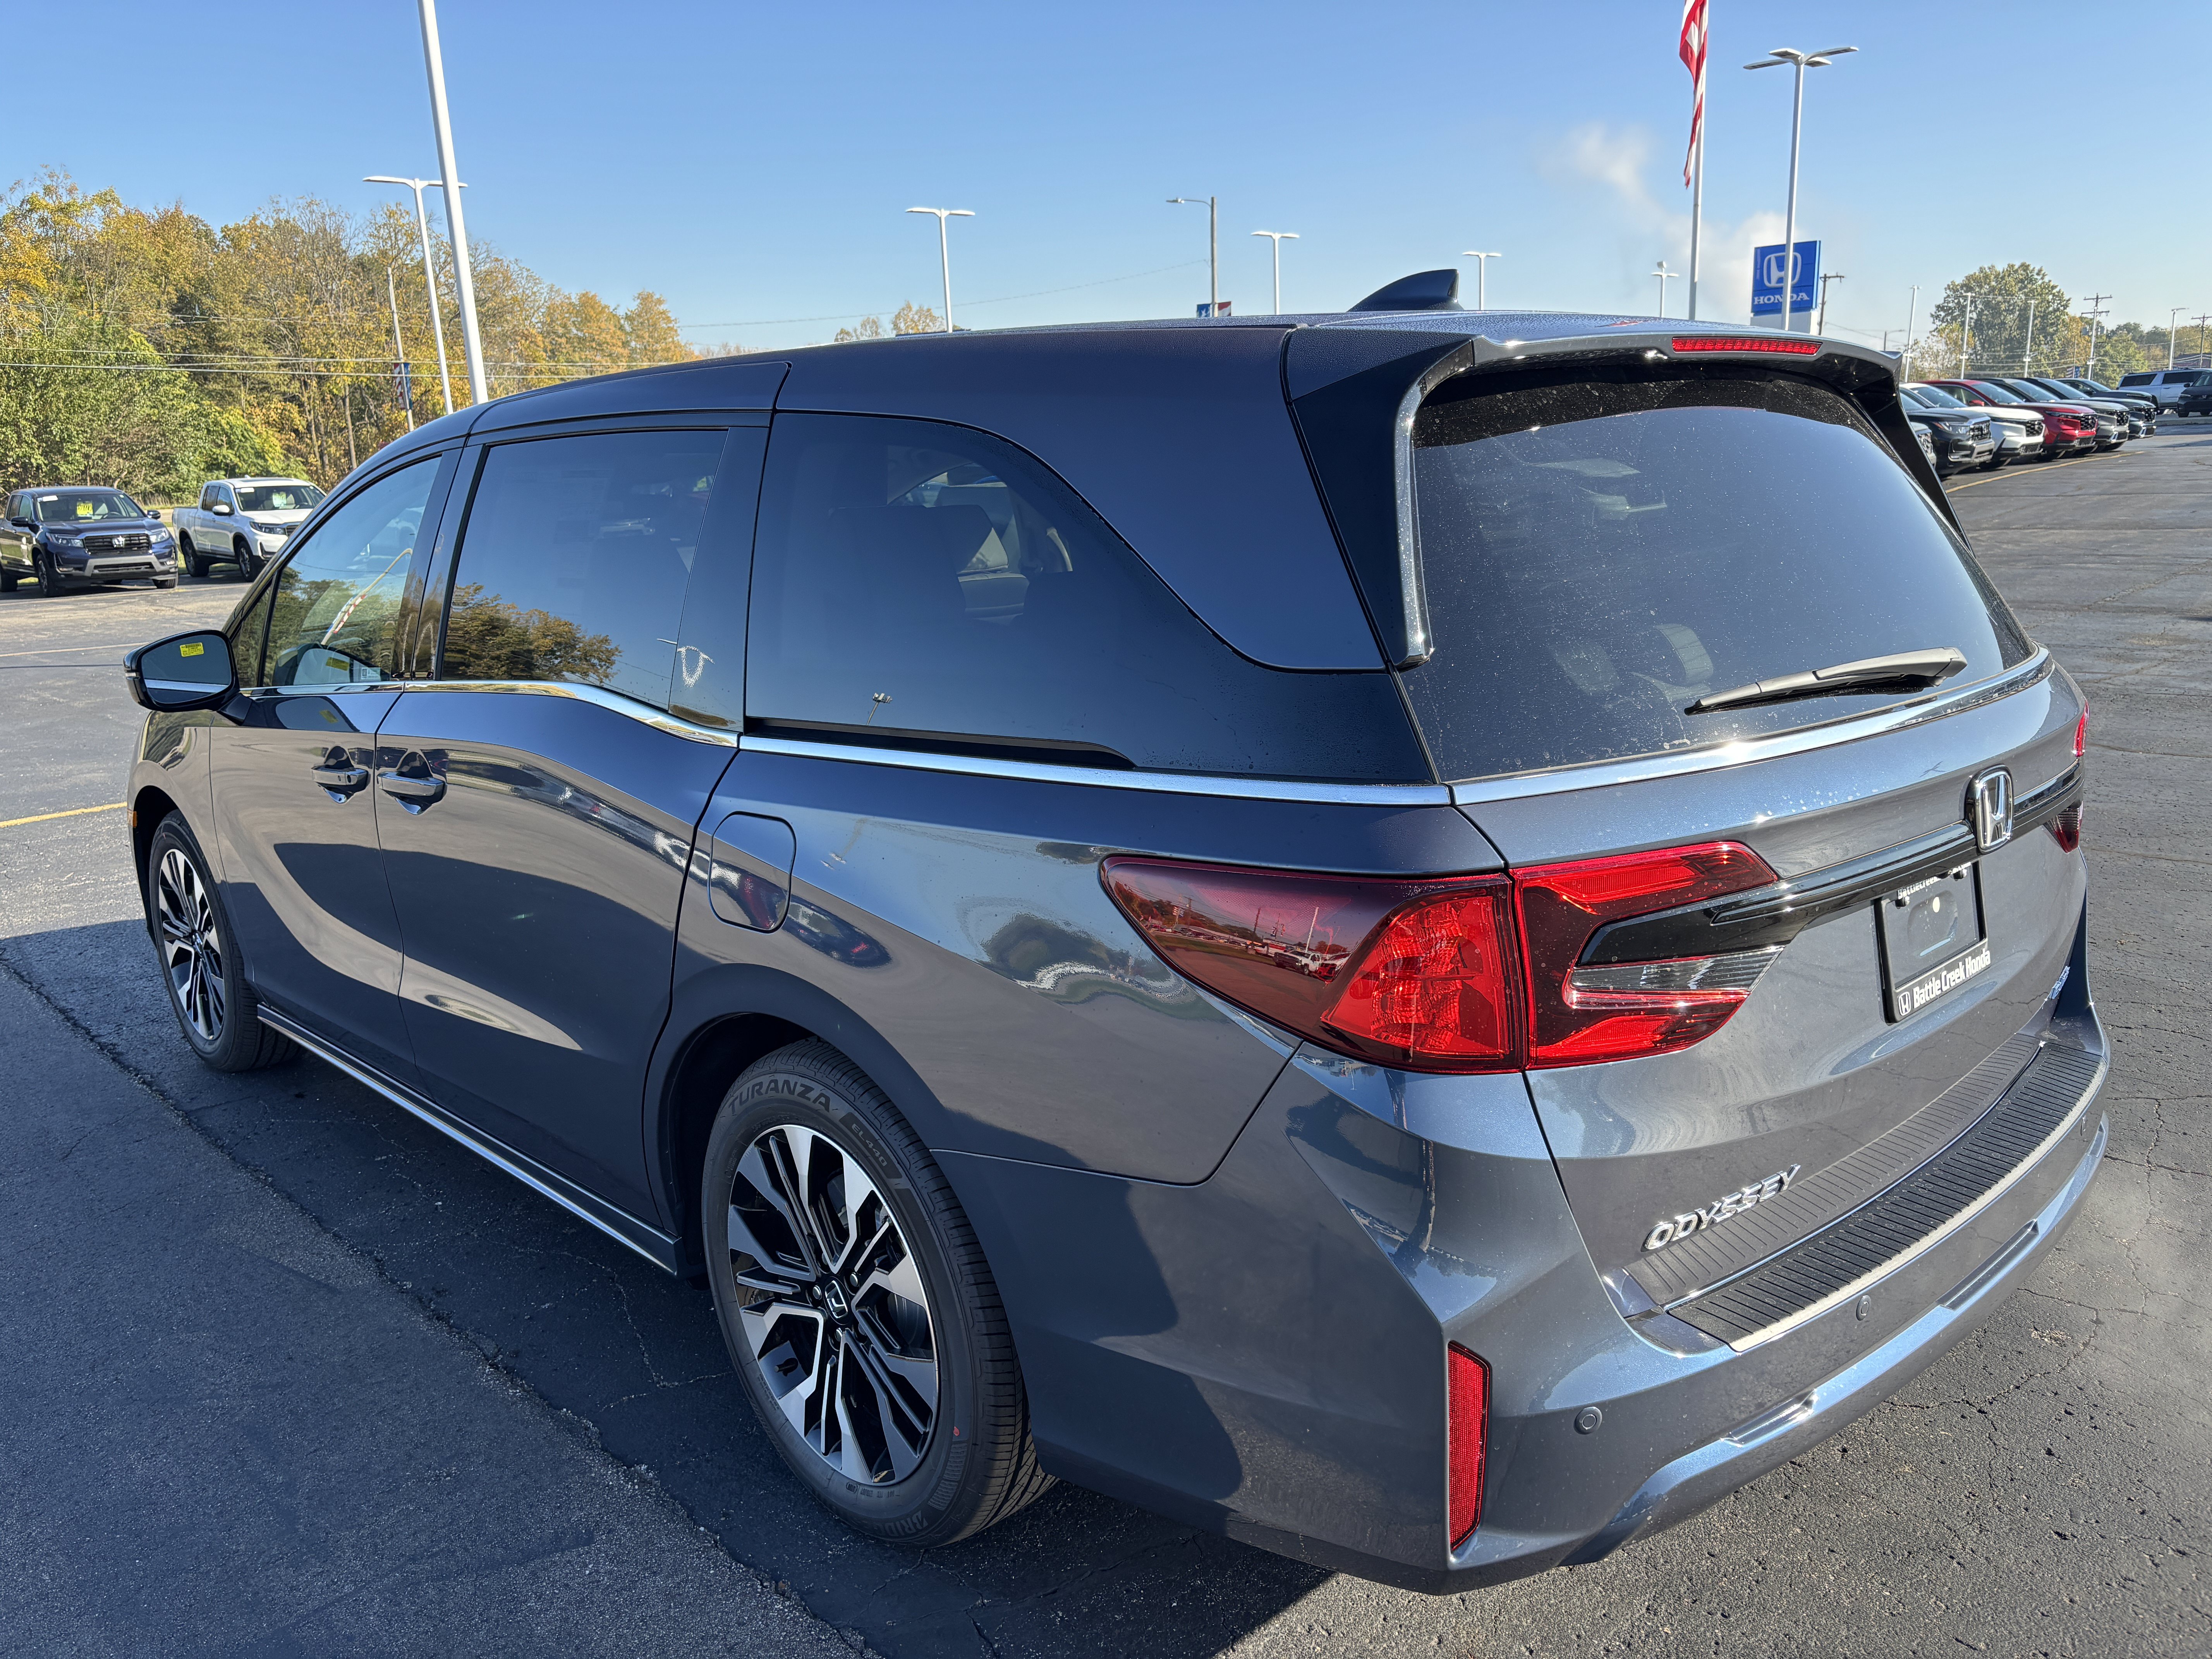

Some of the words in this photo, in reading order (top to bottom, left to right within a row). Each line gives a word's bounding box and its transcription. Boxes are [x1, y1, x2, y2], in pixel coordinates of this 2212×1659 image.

[1753, 292, 1810, 304] HONDA
[1913, 977, 1941, 1009] Battle
[1941, 962, 1965, 991] Creek
[1965, 948, 1991, 977] Honda
[728, 1079, 831, 1115] TURANZA
[852, 1123, 887, 1167] EL440
[1644, 1164, 1802, 1250] ODYSSEY
